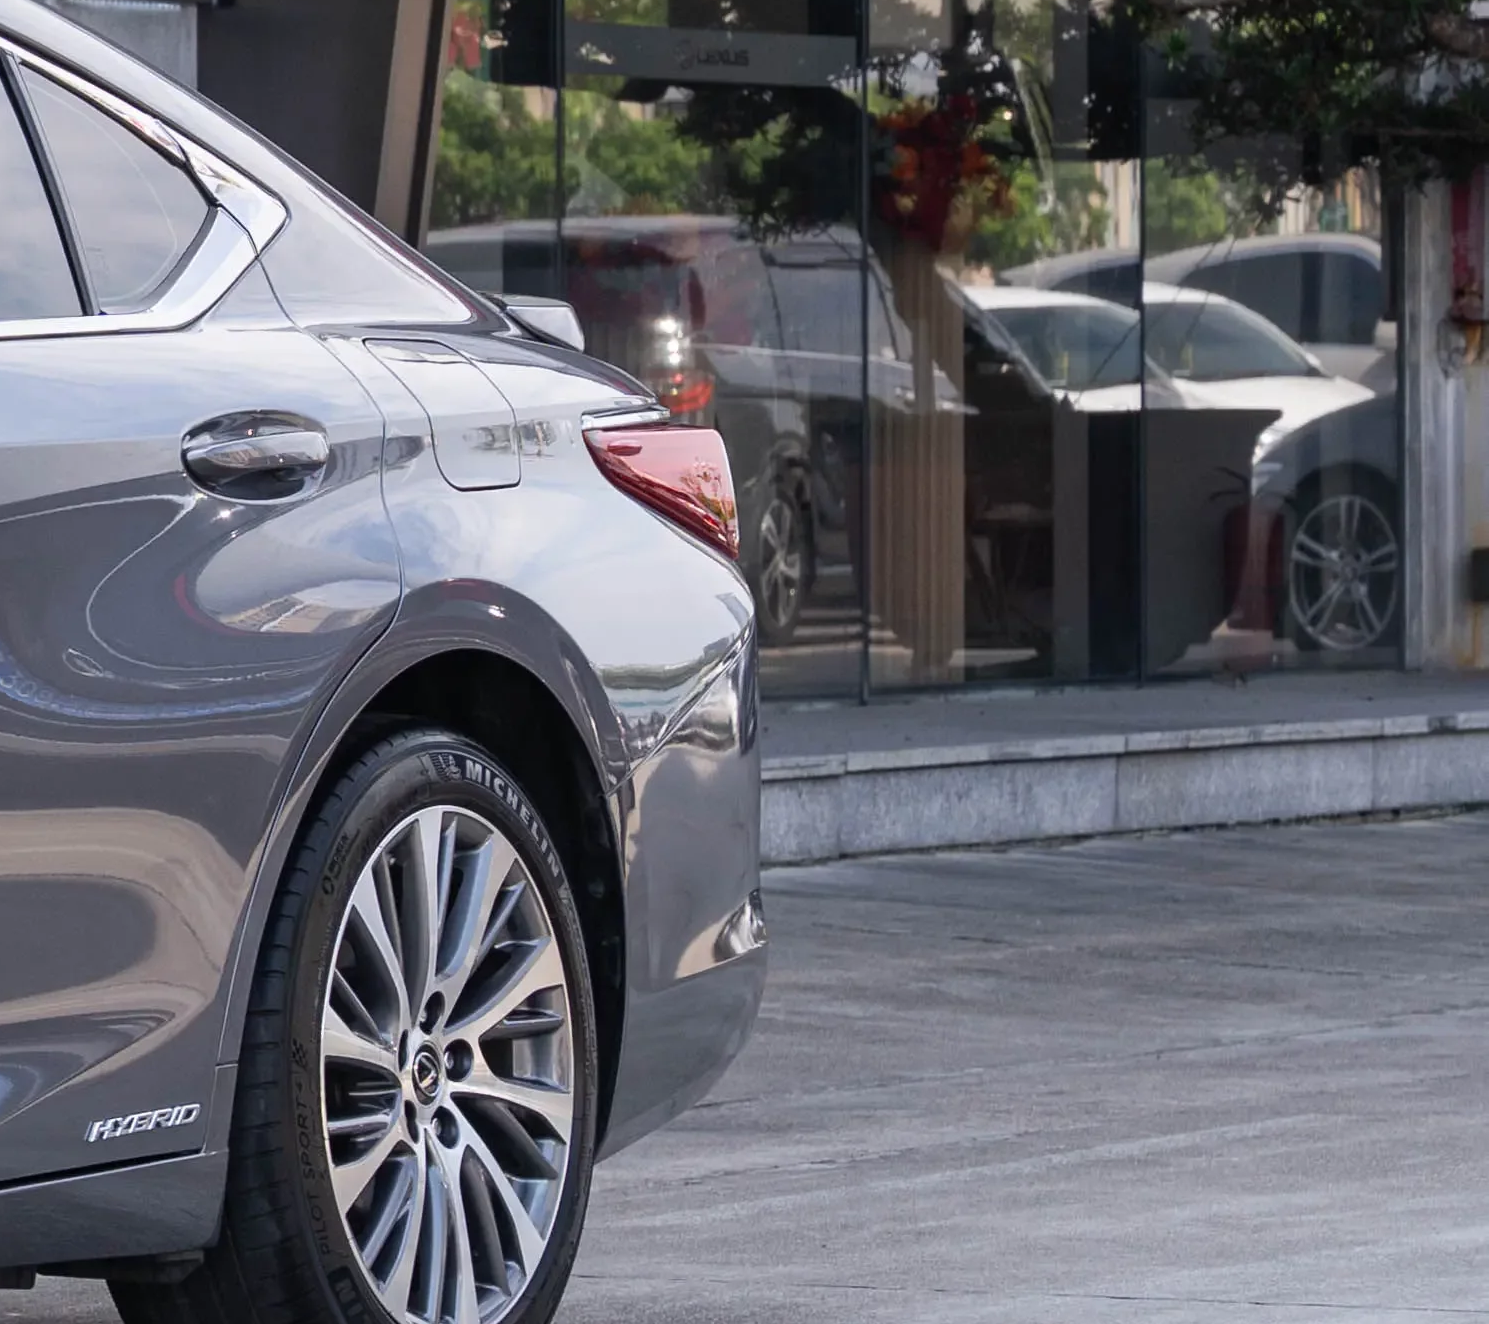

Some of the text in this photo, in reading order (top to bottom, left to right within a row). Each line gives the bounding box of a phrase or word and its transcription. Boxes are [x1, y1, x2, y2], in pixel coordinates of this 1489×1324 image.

[695, 47, 751, 68] LEXUS
[464, 758, 560, 878] MICHELIN
[84, 1102, 202, 1144] HYBRID
[294, 1100, 317, 1180] SPORT
[306, 1193, 331, 1256] PILOT
